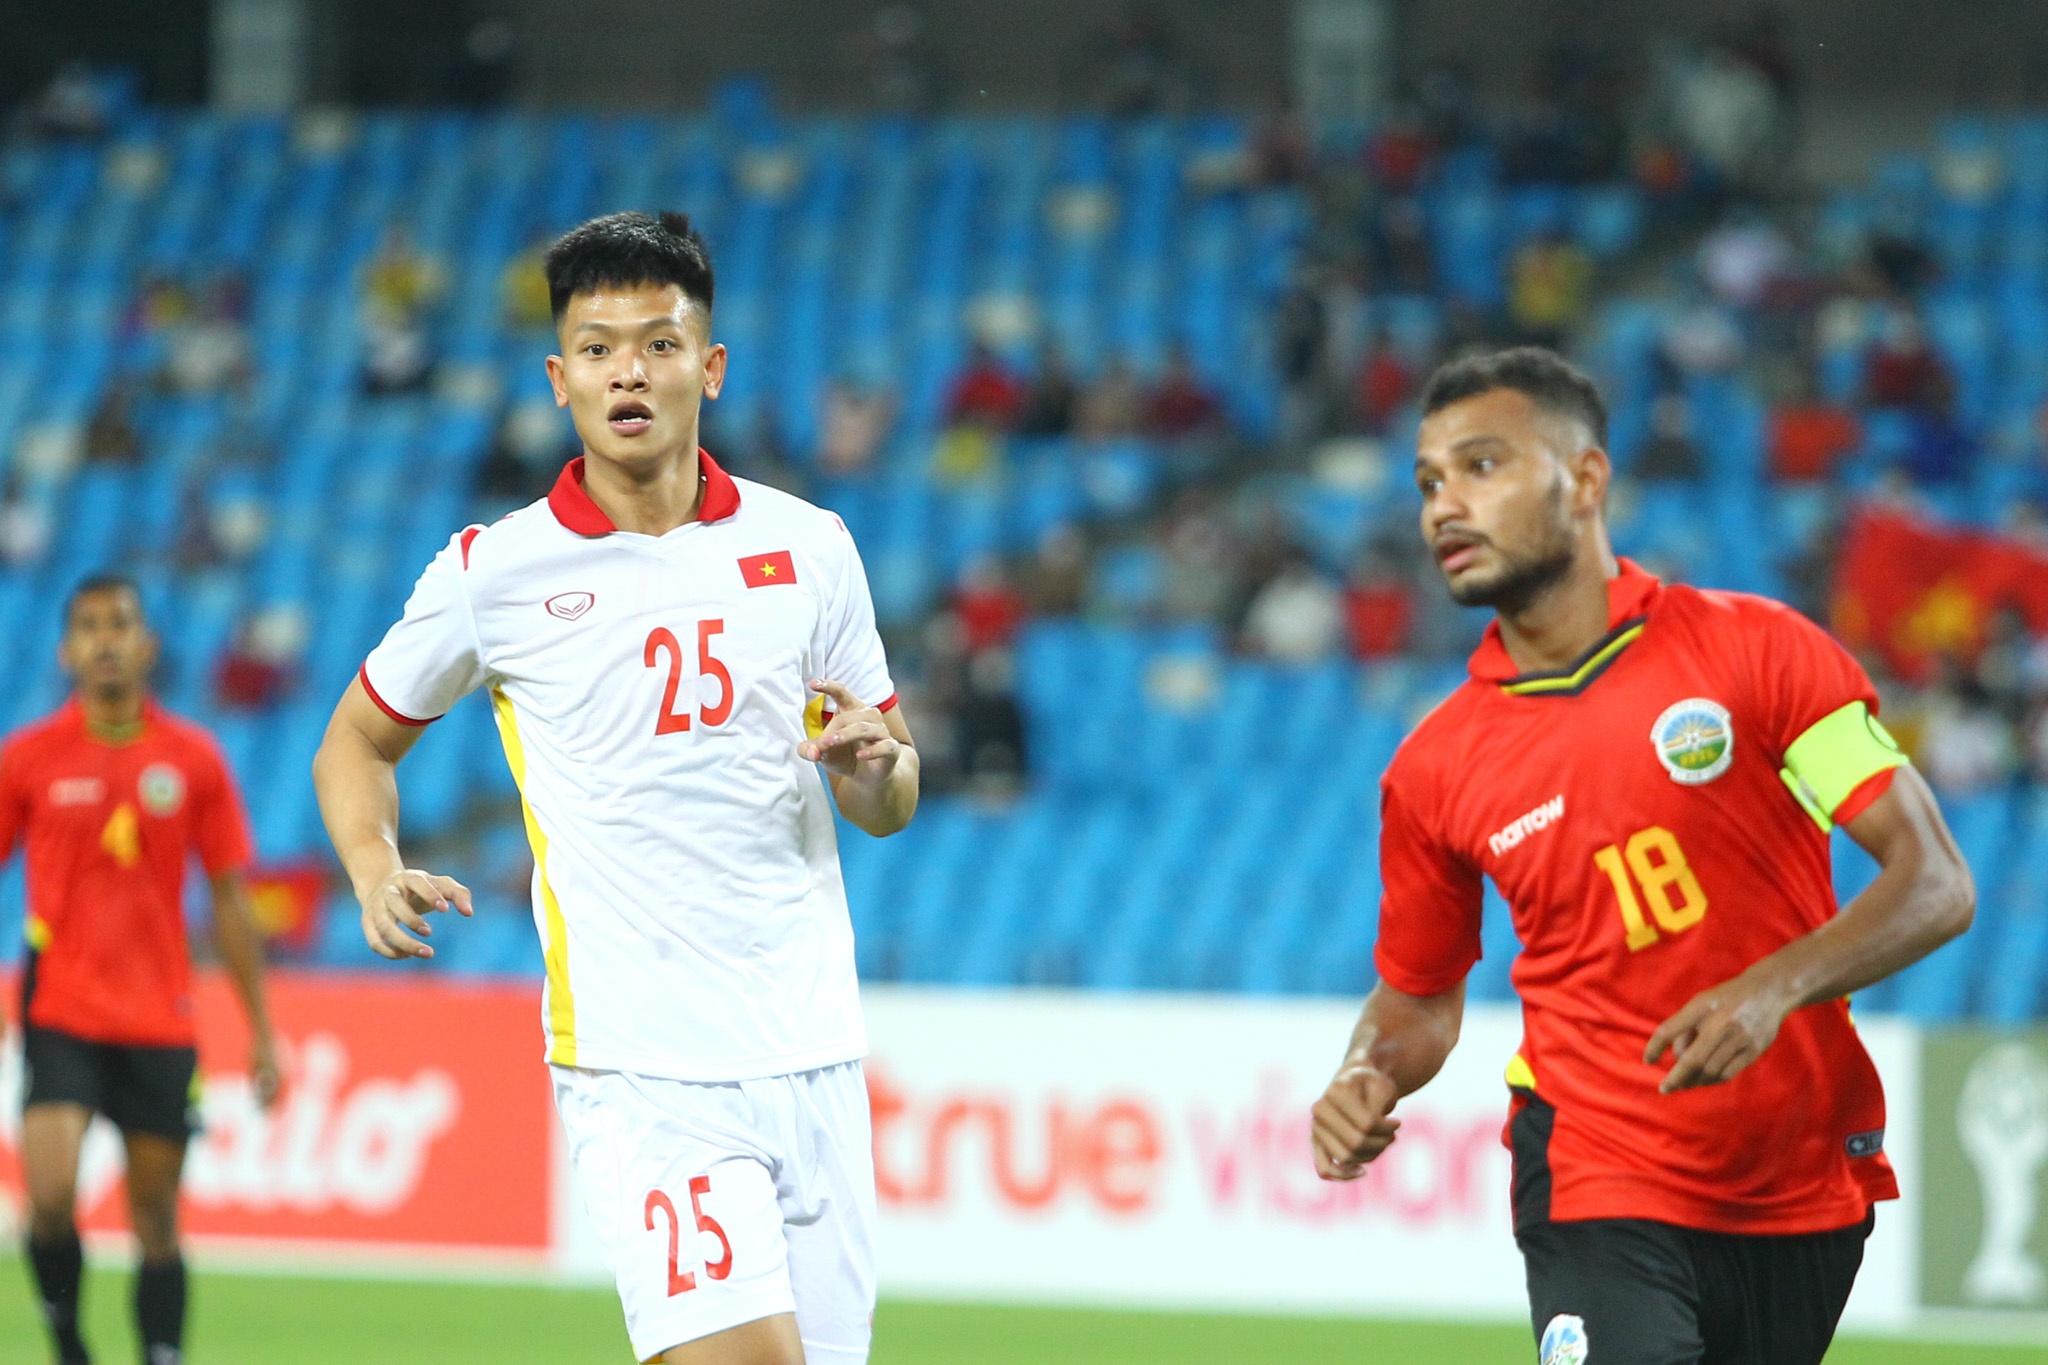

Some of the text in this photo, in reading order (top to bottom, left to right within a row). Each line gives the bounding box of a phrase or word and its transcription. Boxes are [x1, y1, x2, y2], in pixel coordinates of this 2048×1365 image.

[644, 618, 734, 736] 25
[1488, 794, 1564, 857] narrow
[1594, 826, 1708, 952] 18
[866, 1062, 1162, 1215] true
[644, 1175, 732, 1297] 25
